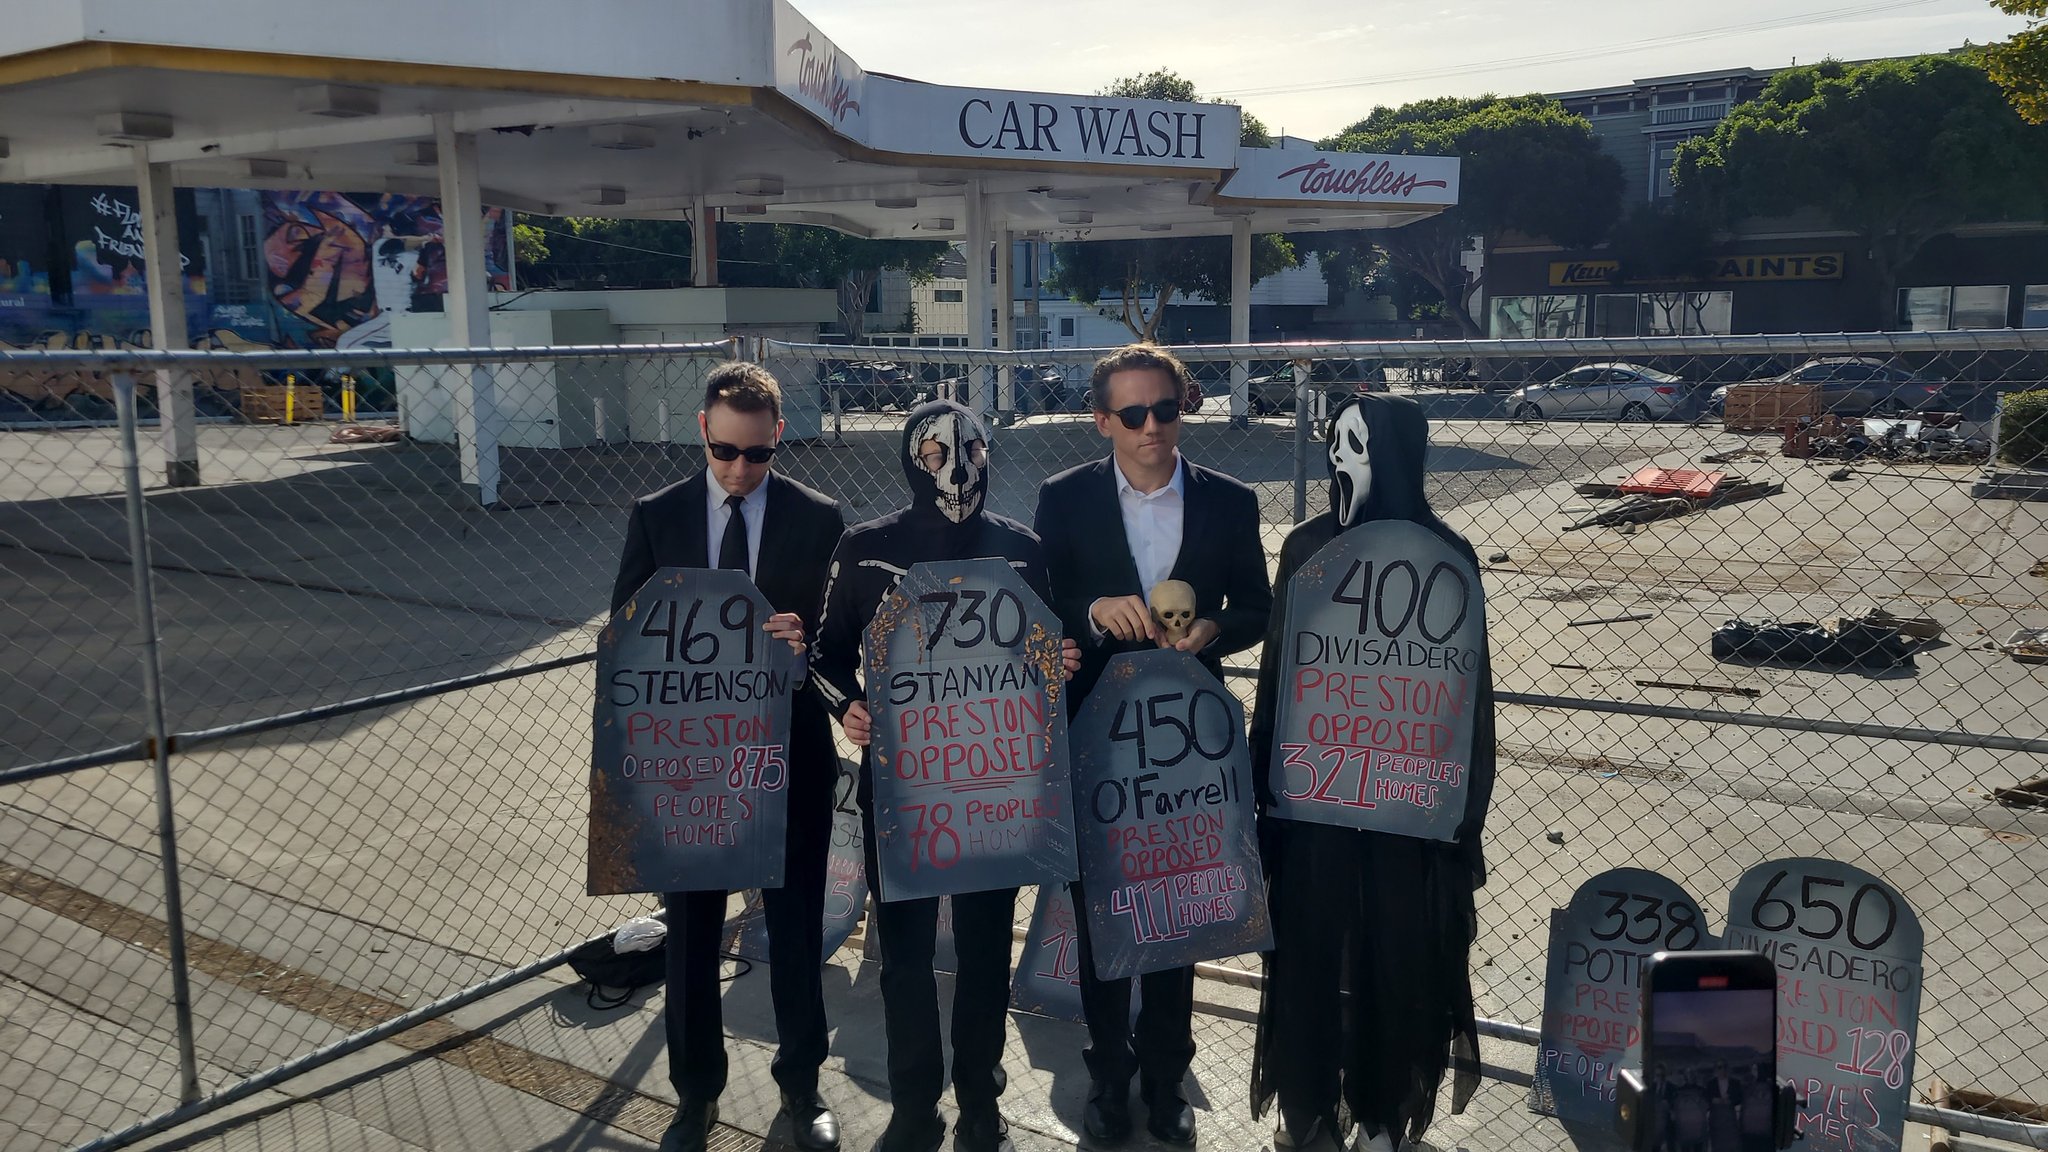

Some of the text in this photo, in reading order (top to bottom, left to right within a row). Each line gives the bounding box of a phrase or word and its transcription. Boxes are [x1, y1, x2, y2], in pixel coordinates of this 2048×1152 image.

[957, 98, 1206, 160] CAR WASH
[920, 588, 1027, 650] 730
[1332, 557, 1471, 646] 400
[639, 594, 755, 665] 469
[1295, 631, 1480, 675] DIVISADERO
[610, 669, 789, 707] STEVENSON
[889, 662, 1040, 706] STANYAN
[1295, 667, 1468, 718] PRESTON
[627, 712, 774, 749] PRESTON
[899, 693, 1046, 744] PRESTON
[1108, 688, 1235, 768] 450
[1307, 712, 1454, 758] OPPOSED
[621, 744, 787, 793] OPPOSED 875
[895, 733, 1052, 782] OPPOSED
[1280, 743, 1377, 810] 321
[1091, 766, 1239, 823] O'Farrell
[1374, 777, 1439, 810] HOMES
[662, 820, 740, 847] HOMES
[899, 802, 962, 872] 78
[1107, 809, 1224, 849] PRESTON
[1120, 834, 1222, 882] OPPOSED
[1111, 877, 1189, 944] 411
[1177, 894, 1236, 927] HOMES
[1591, 892, 1700, 951] 338
[1752, 871, 1896, 950] 650
[1777, 975, 1899, 1030] RESTON
[1835, 1027, 1911, 1090] 128
